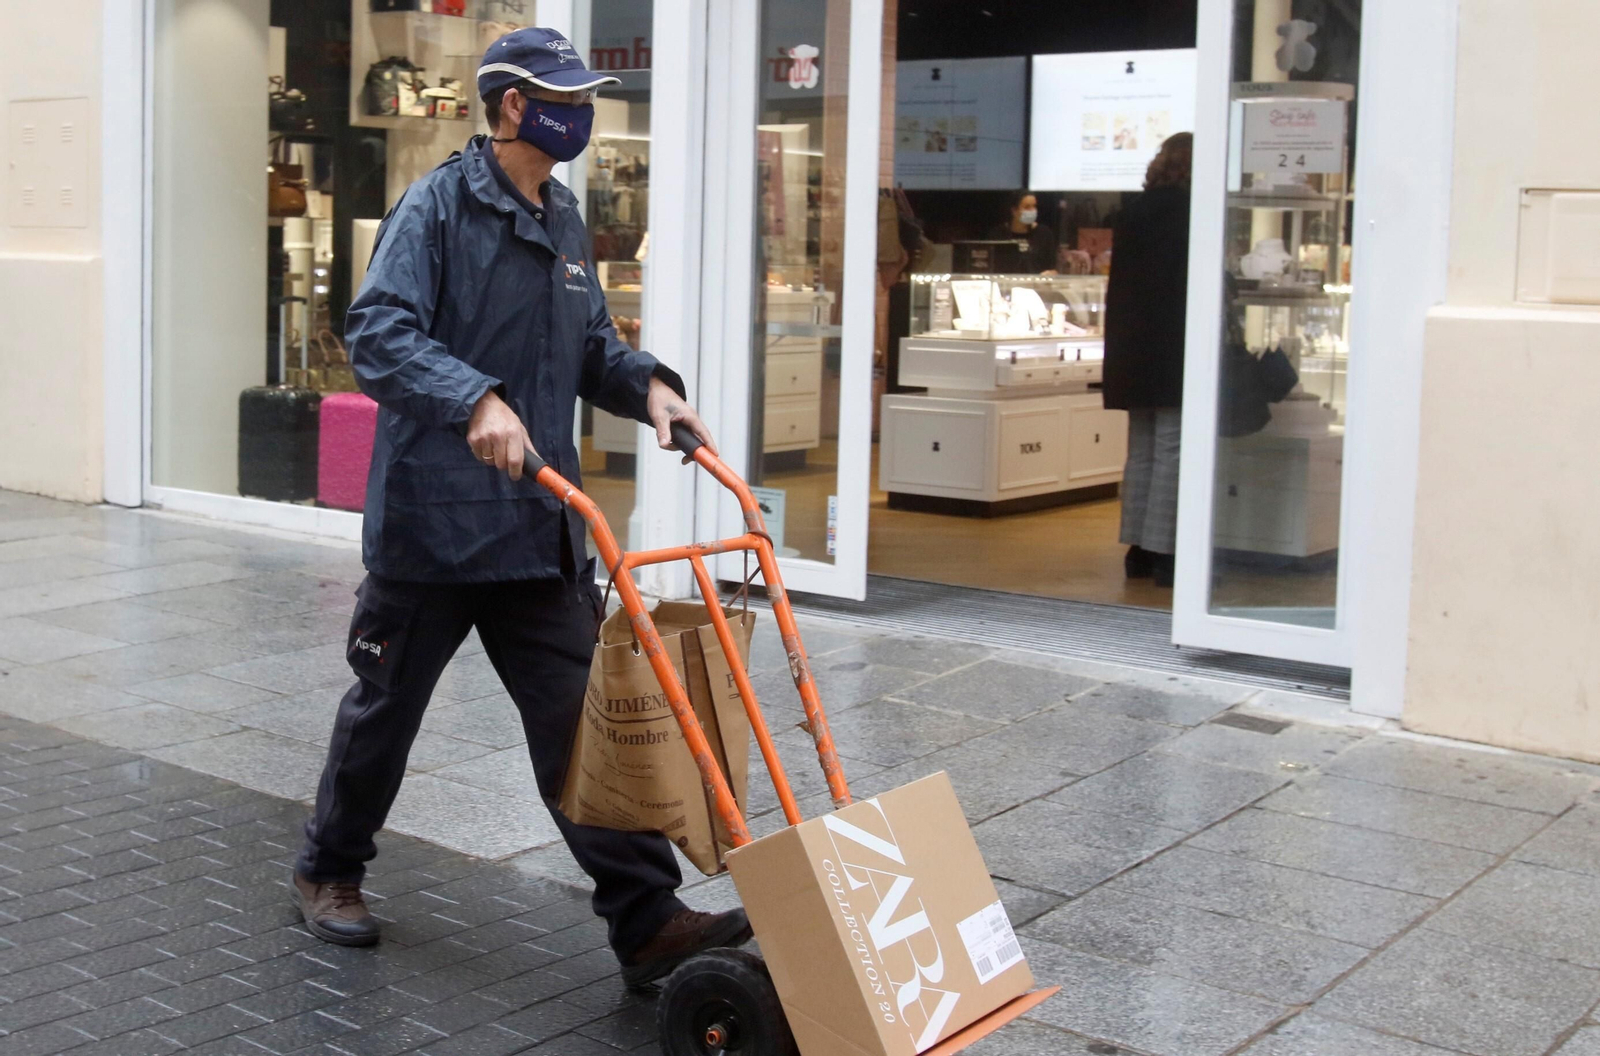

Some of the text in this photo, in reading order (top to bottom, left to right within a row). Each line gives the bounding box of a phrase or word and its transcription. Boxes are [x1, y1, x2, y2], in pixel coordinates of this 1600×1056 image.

[538, 114, 567, 134] TIPSA
[1020, 442, 1042, 454] TOUS
[605, 692, 670, 714] JIMÉNE
[607, 727, 669, 746] Hombre
[822, 797, 961, 1055] ZARA
[822, 858, 896, 1025] COLLECTION 20
